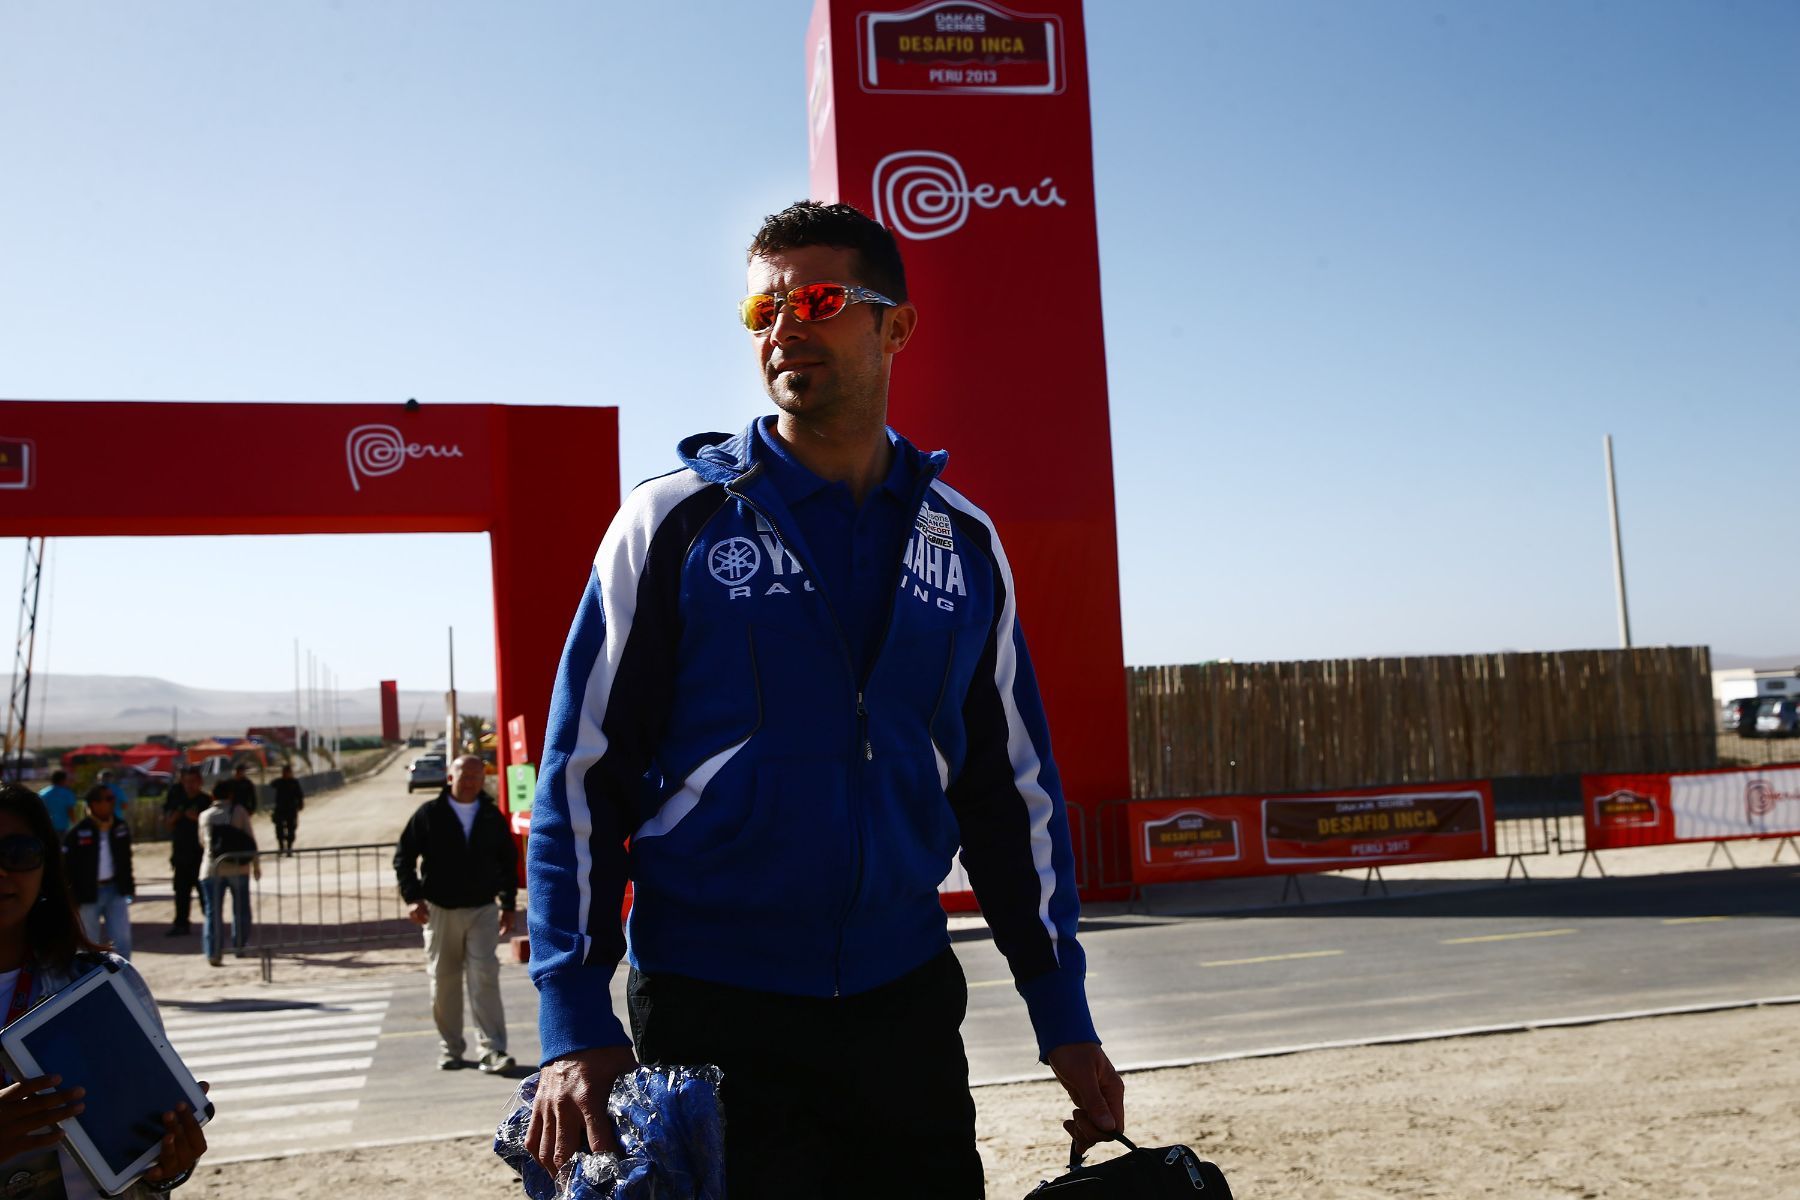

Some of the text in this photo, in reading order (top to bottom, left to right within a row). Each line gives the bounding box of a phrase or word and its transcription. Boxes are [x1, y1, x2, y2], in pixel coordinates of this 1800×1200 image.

[935, 13, 985, 23] DAKAR
[899, 36, 1025, 53] DESAFIO INCA
[929, 69, 997, 83] PERU 2013
[928, 534, 953, 548] GAMES
[1317, 809, 1438, 835] DESAFIO INCA
